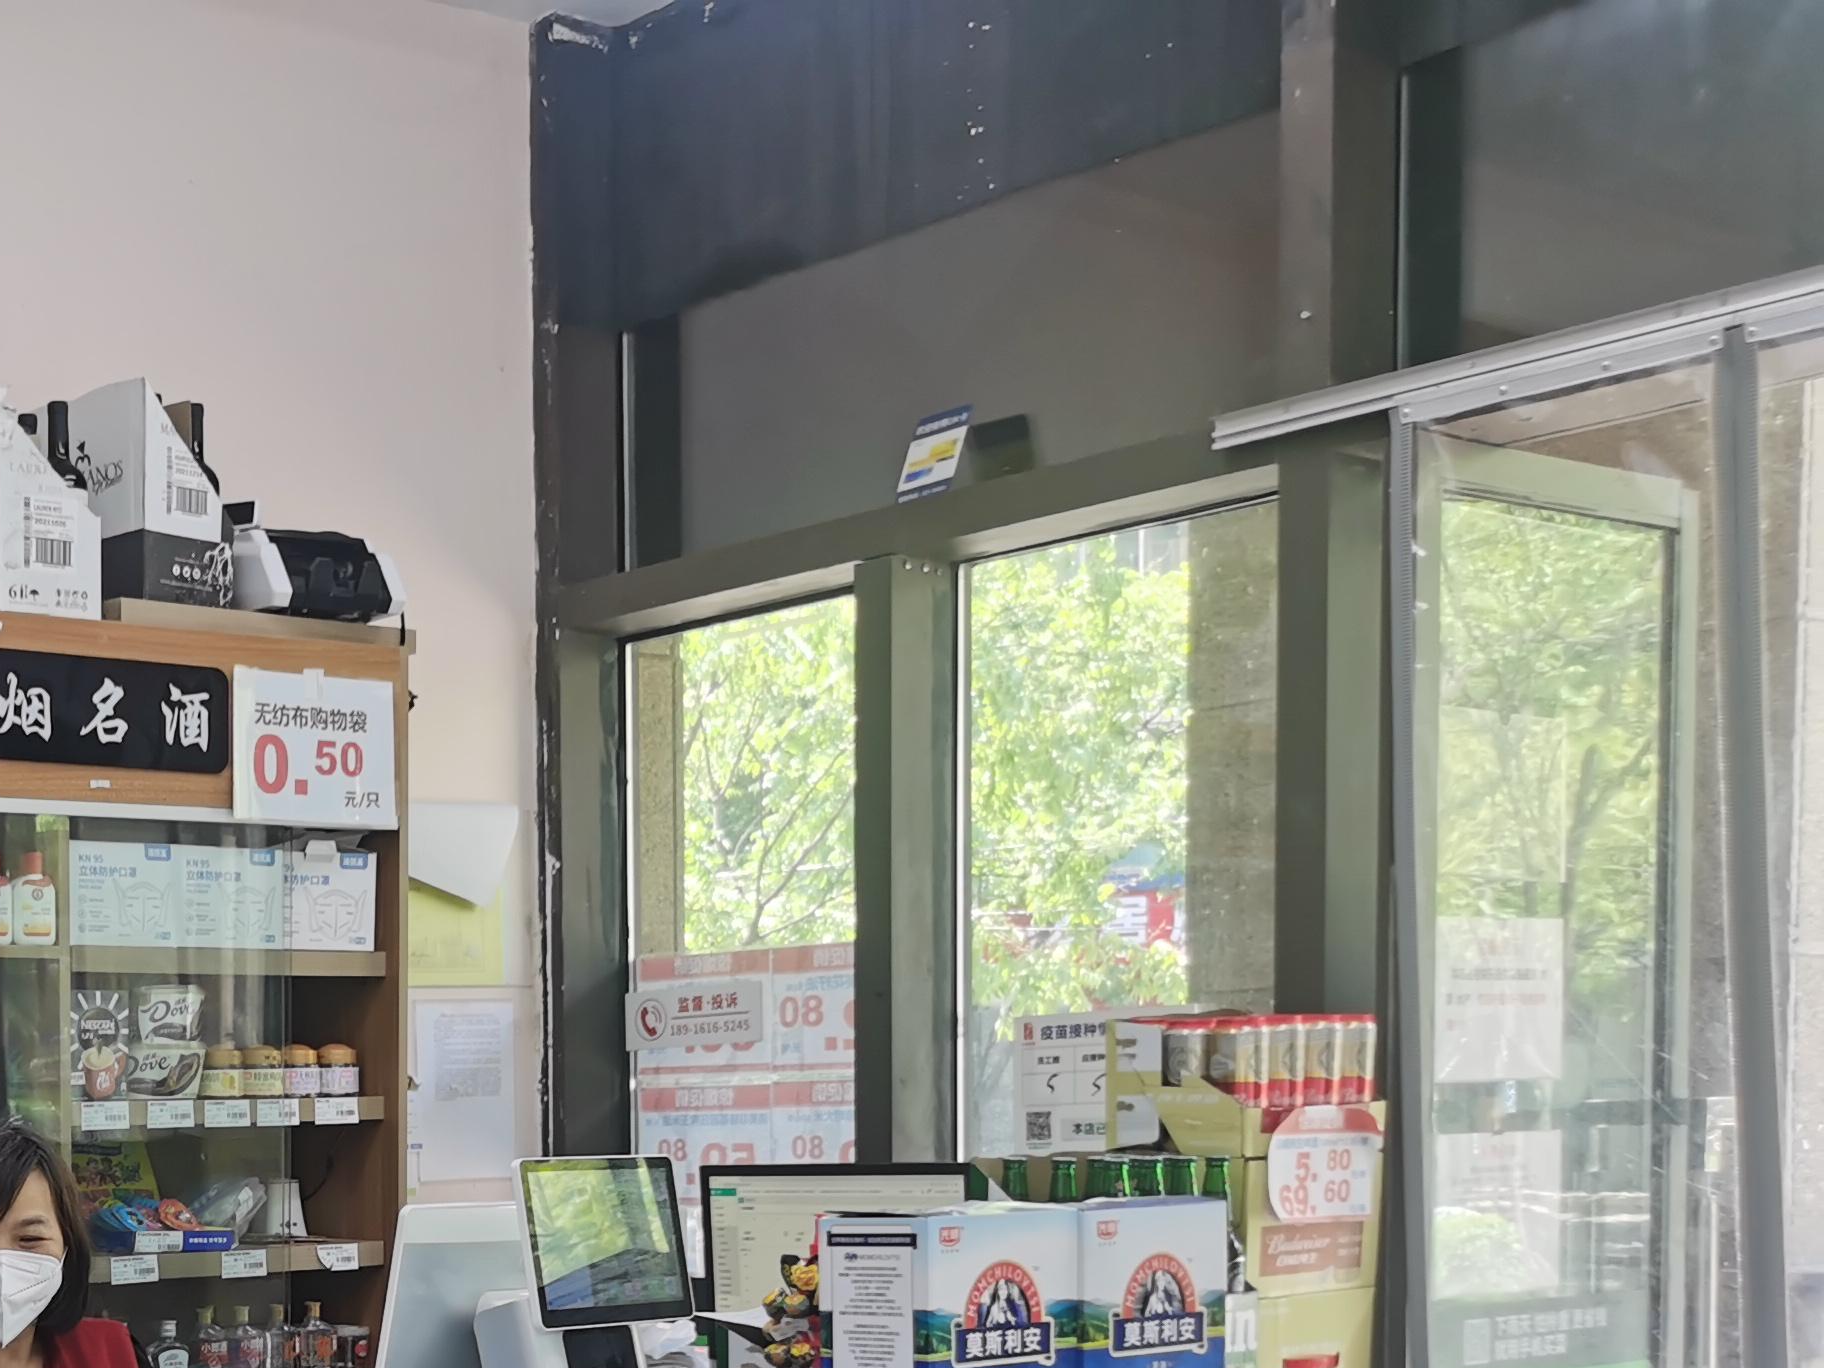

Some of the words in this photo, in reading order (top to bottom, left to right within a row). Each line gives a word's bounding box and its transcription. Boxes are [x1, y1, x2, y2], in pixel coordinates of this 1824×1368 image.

[254, 702, 367, 734] 无纺布购物袋
[253, 734, 364, 796] 0.50
[344, 790, 380, 809] 元/只
[964, 1331, 1043, 1360] 莫斯利安
[1123, 1317, 1197, 1346] 莫斯利安
